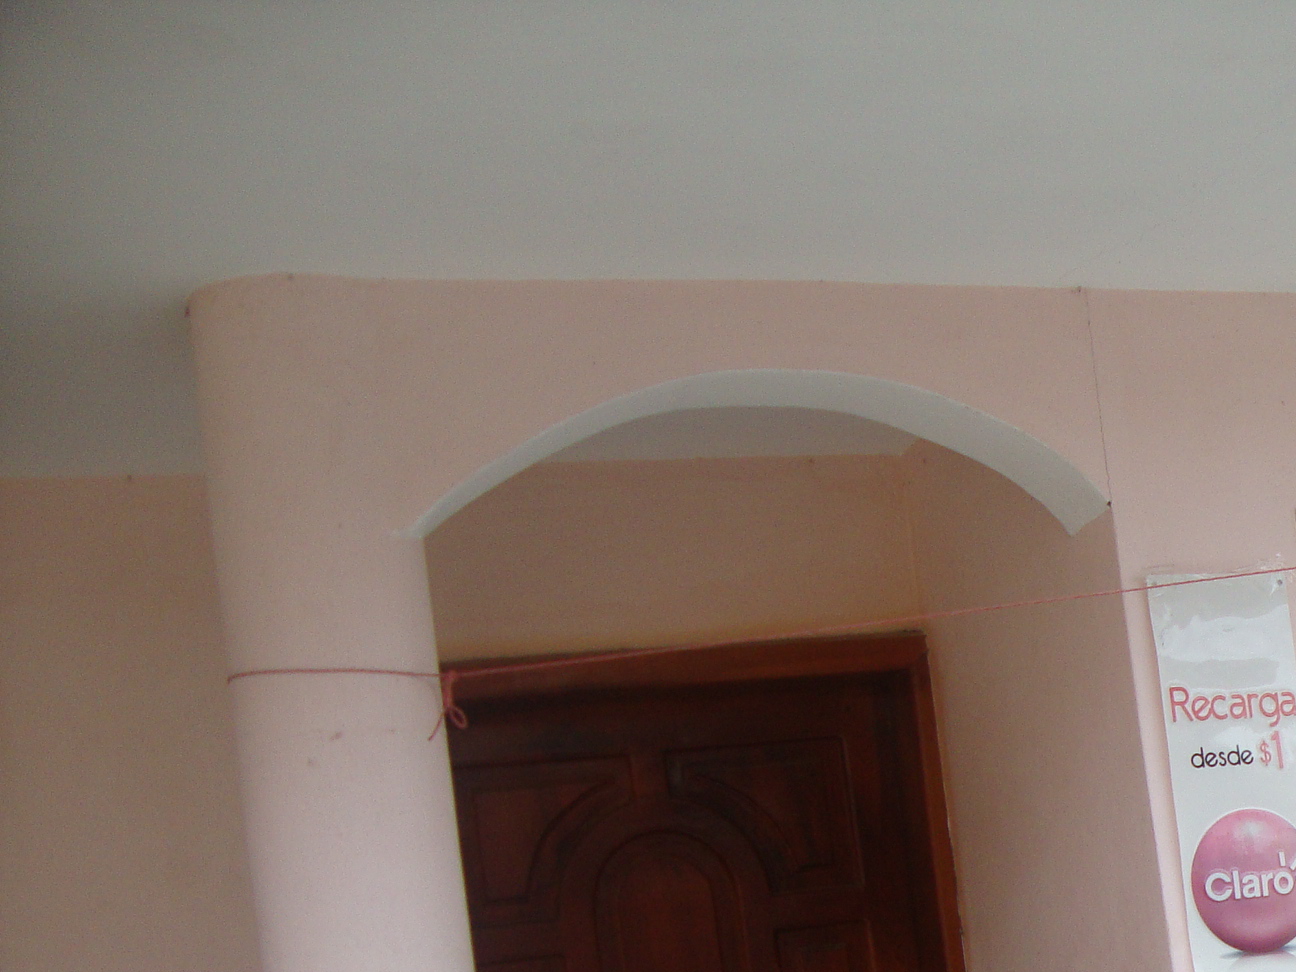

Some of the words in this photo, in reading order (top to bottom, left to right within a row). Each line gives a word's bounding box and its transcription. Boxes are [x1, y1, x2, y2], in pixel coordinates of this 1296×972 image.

[1191, 745, 1255, 769] desde
[1259, 730, 1284, 769] $1
[1204, 868, 1296, 902] Claro
